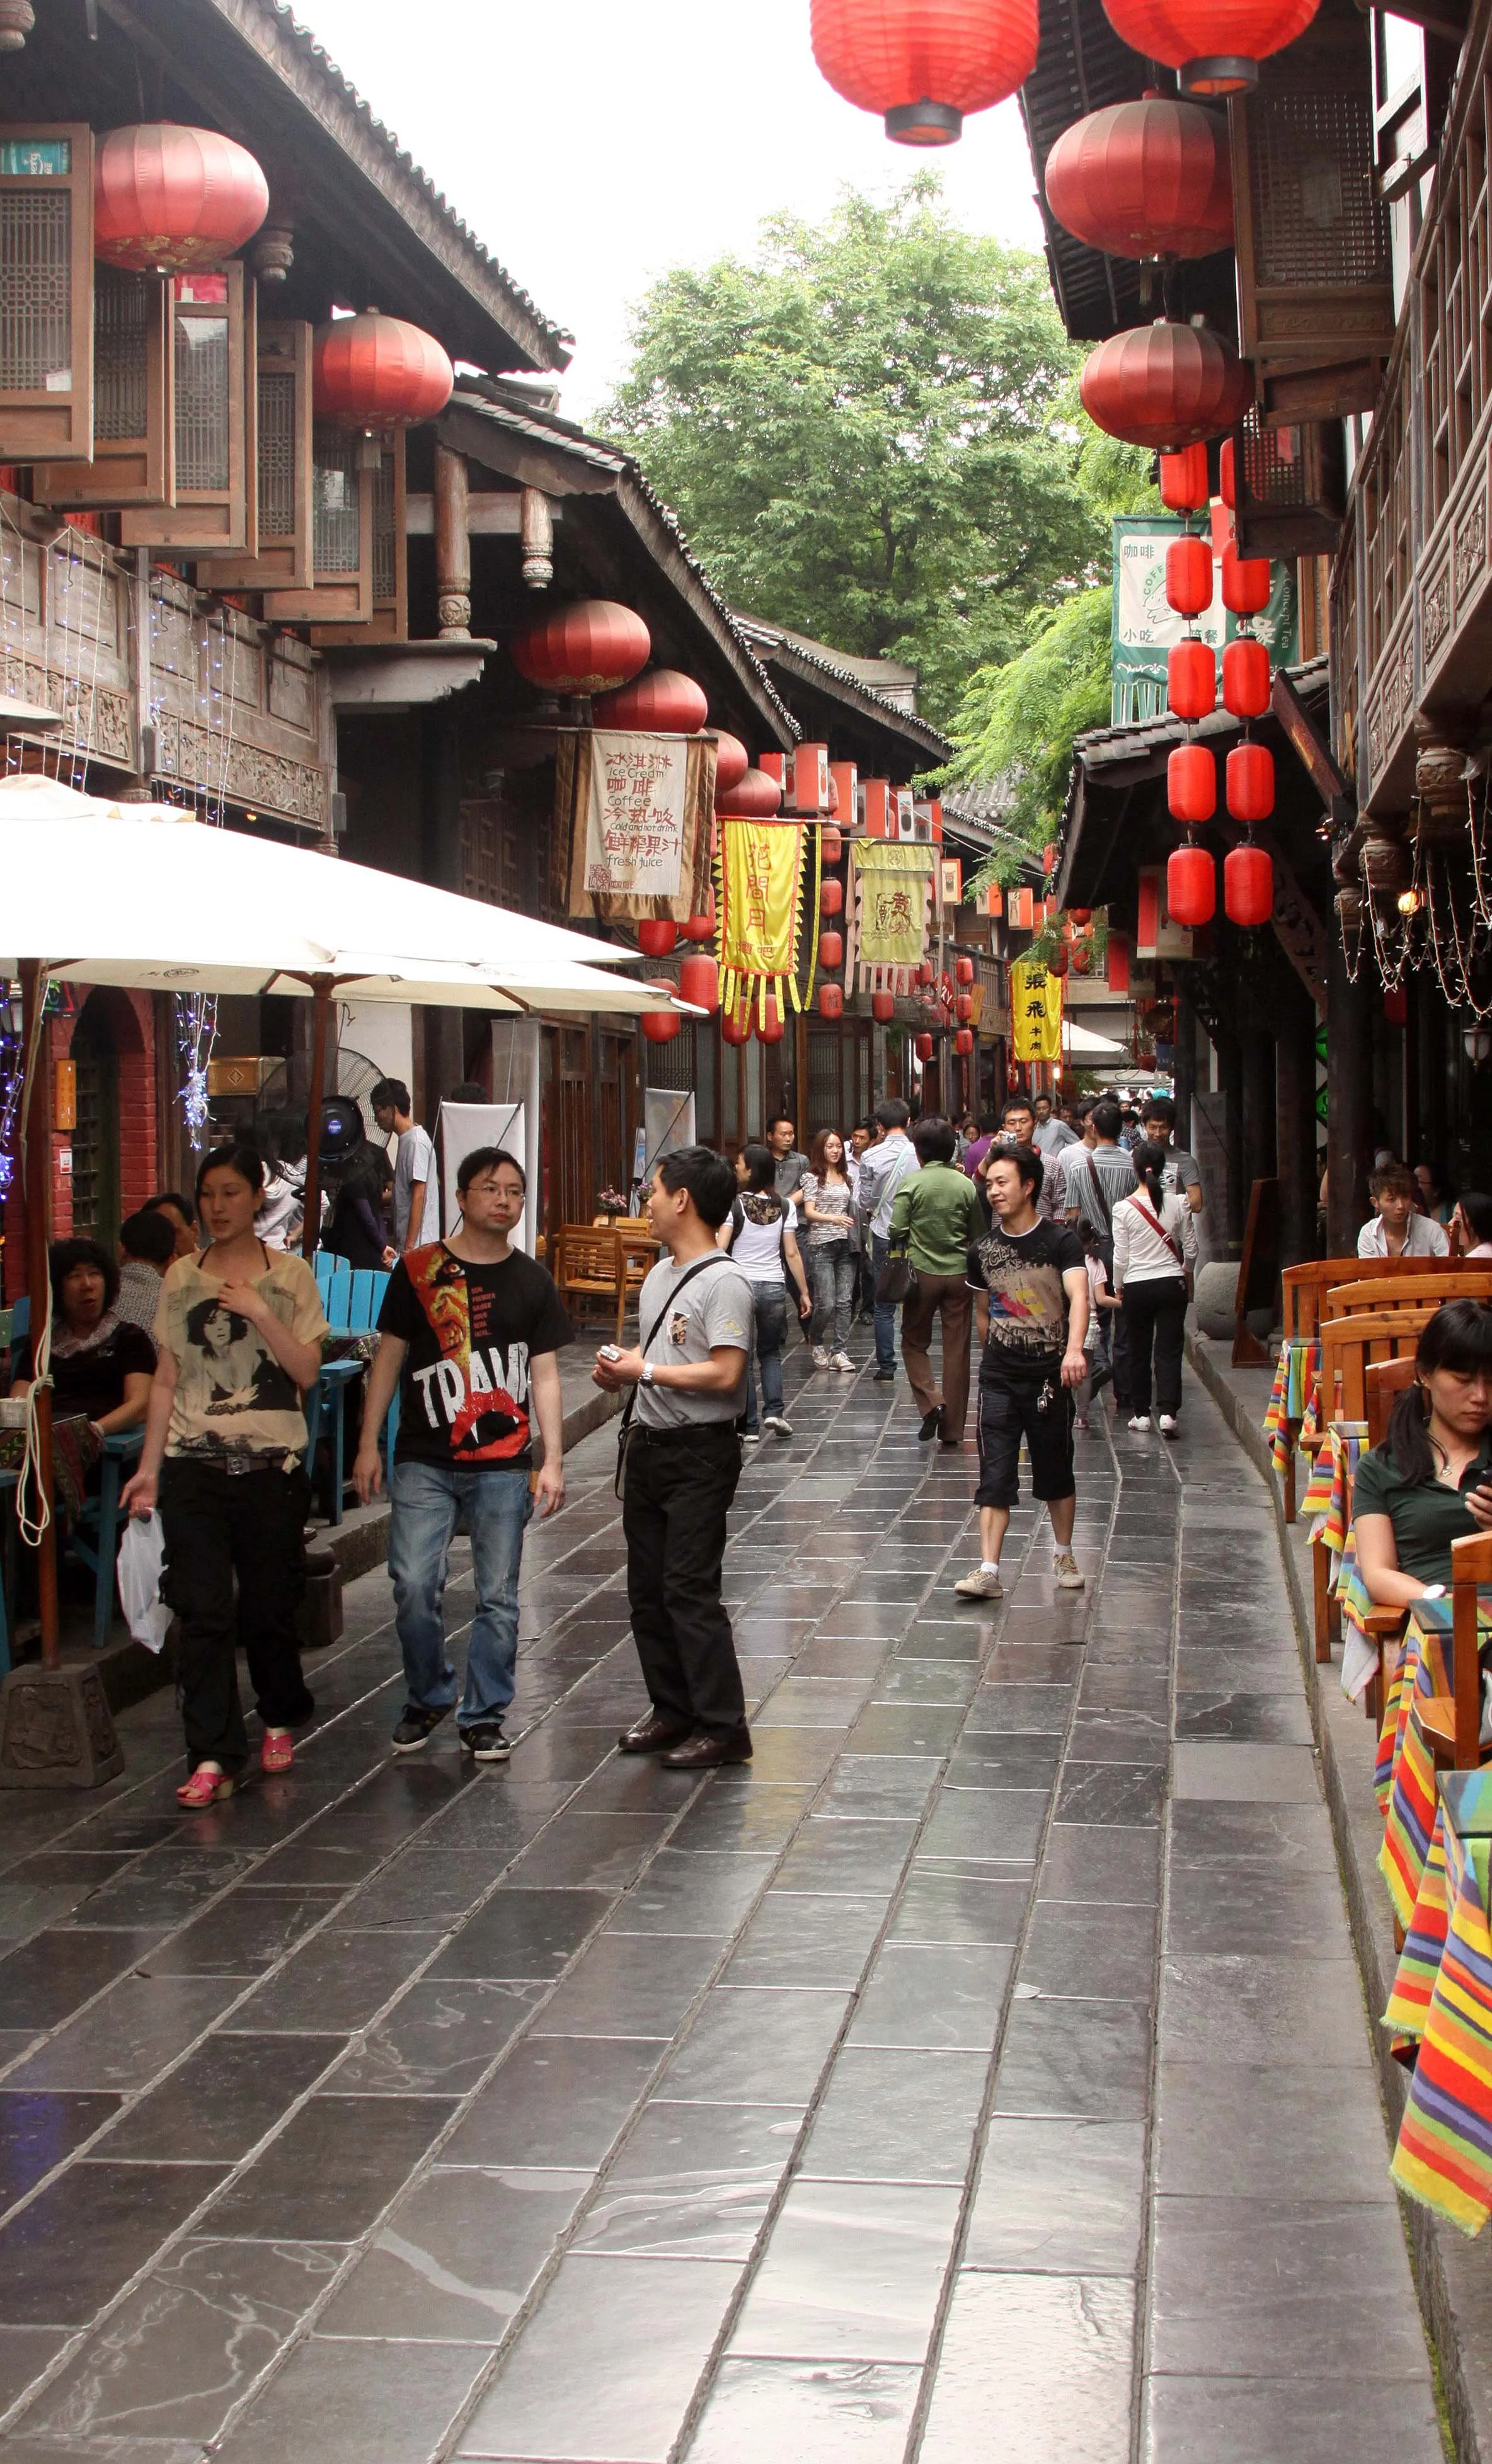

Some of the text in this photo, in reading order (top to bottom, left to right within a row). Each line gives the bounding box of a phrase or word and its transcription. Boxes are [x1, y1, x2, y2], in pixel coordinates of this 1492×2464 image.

[1124, 544, 1154, 559] 咖啡
[1144, 565, 1164, 595] COFF
[1282, 578, 1291, 625] Concept
[1123, 629, 1154, 642] 小吃
[1282, 630, 1291, 648] Tea
[605, 752, 673, 769] 冰淇淋
[609, 767, 664, 779] Ice Cream
[607, 777, 656, 796] 咖啡
[607, 796, 651, 807] Coffee
[603, 806, 677, 827] 冷热饮
[601, 829, 681, 857] 鲜榨果汁
[606, 854, 663, 870] fresh juice
[738, 940, 774, 959] 酒吧
